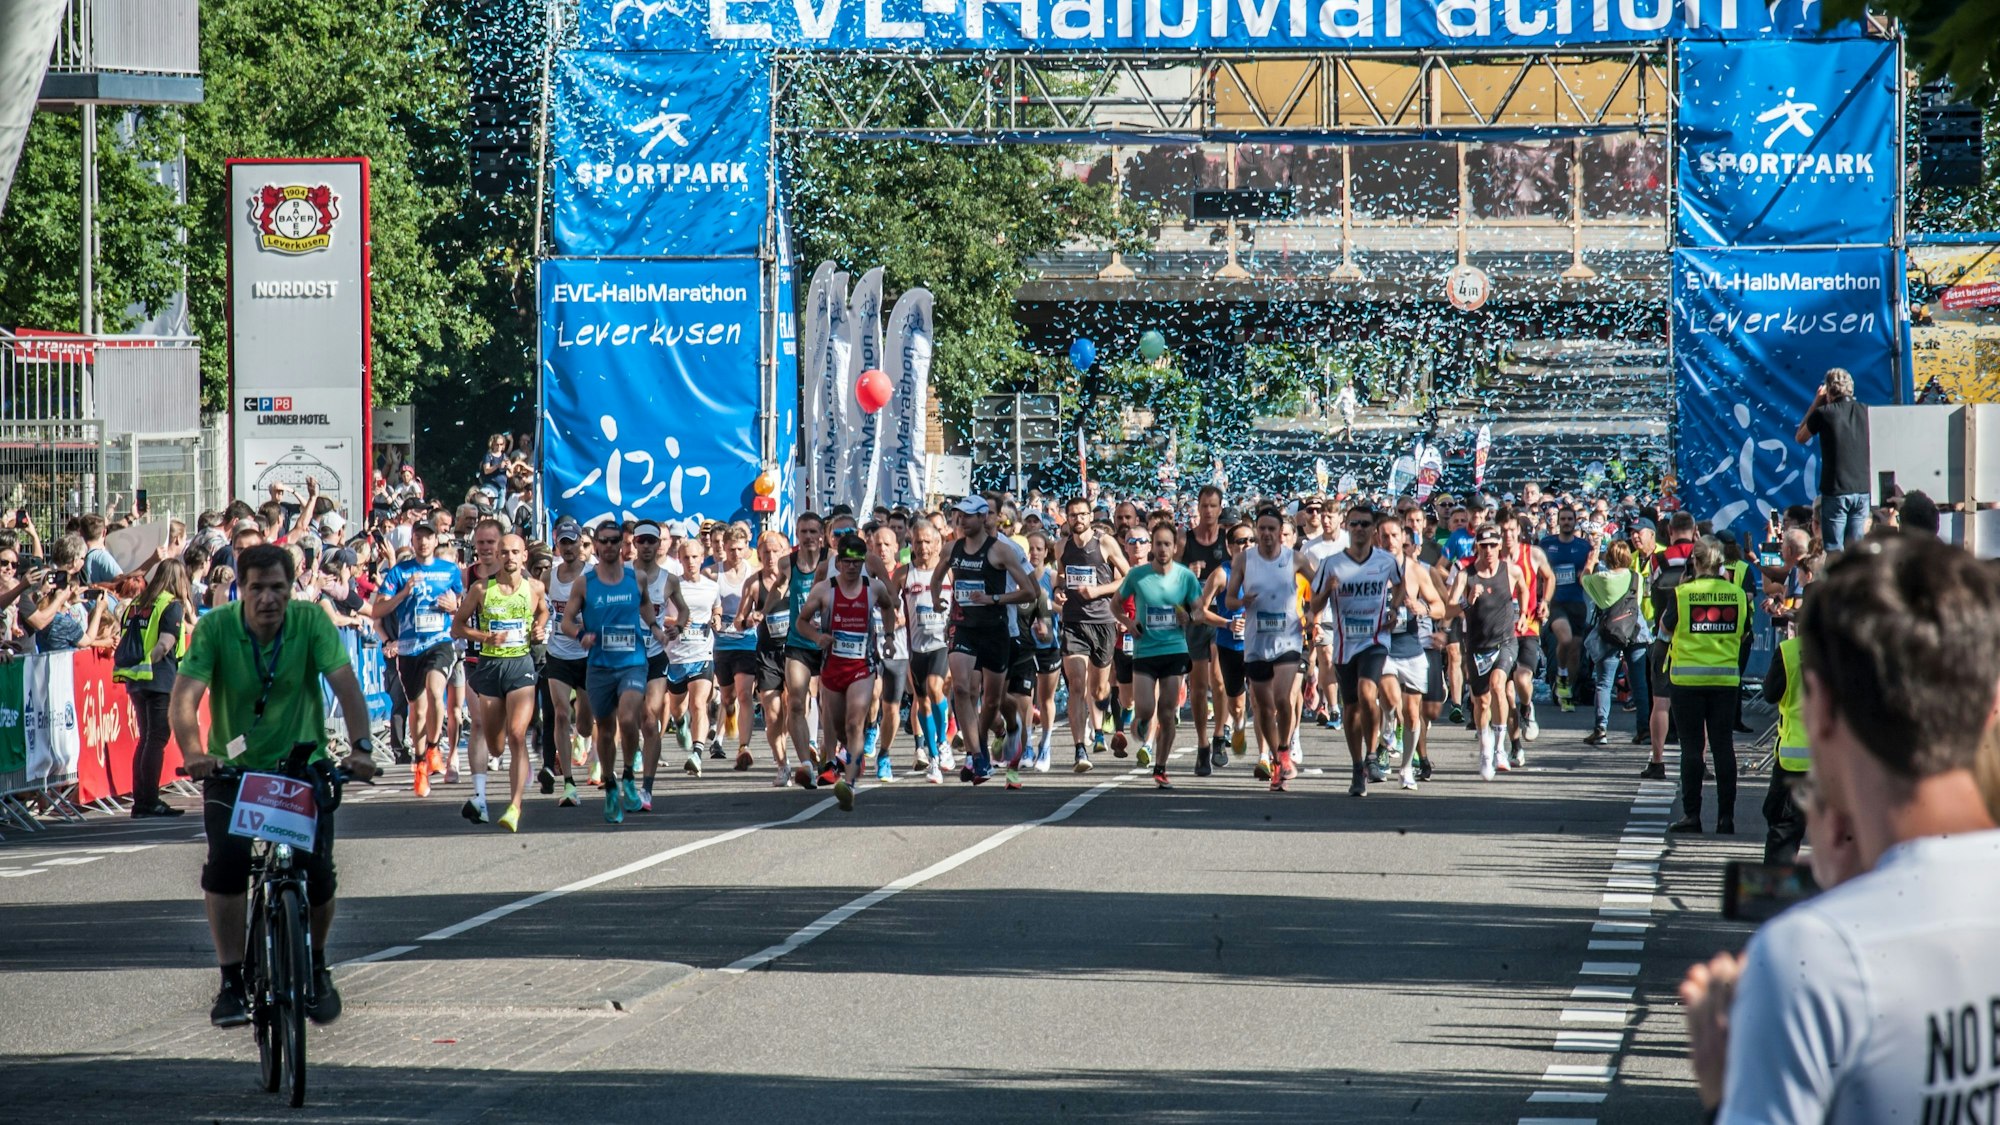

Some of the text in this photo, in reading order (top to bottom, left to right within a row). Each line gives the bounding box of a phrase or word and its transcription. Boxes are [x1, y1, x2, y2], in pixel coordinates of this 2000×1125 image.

[1700, 153, 1874, 174] SPORTPARK
[575, 163, 749, 184] SPORTPARK
[286, 188, 306, 198] 1904
[267, 237, 325, 250] Leverkusen
[255, 281, 338, 297] NORDOST
[1686, 271, 1881, 291] EVL-HalbMarathon
[554, 283, 747, 302] EVL-HalbMarathon
[1689, 307, 1875, 335] Leverkusen
[558, 318, 742, 347] Leverkusen
[262, 398, 290, 410] P P8
[257, 413, 330, 425] LINDNER HOTEL
[1688, 592, 1713, 602] SECURITY
[1718, 592, 1738, 602] SERVICE
[1691, 622, 1735, 632] SECURITAS
[256, 795, 305, 812] Kampfrichter
[1924, 1004, 1981, 1086] NO
